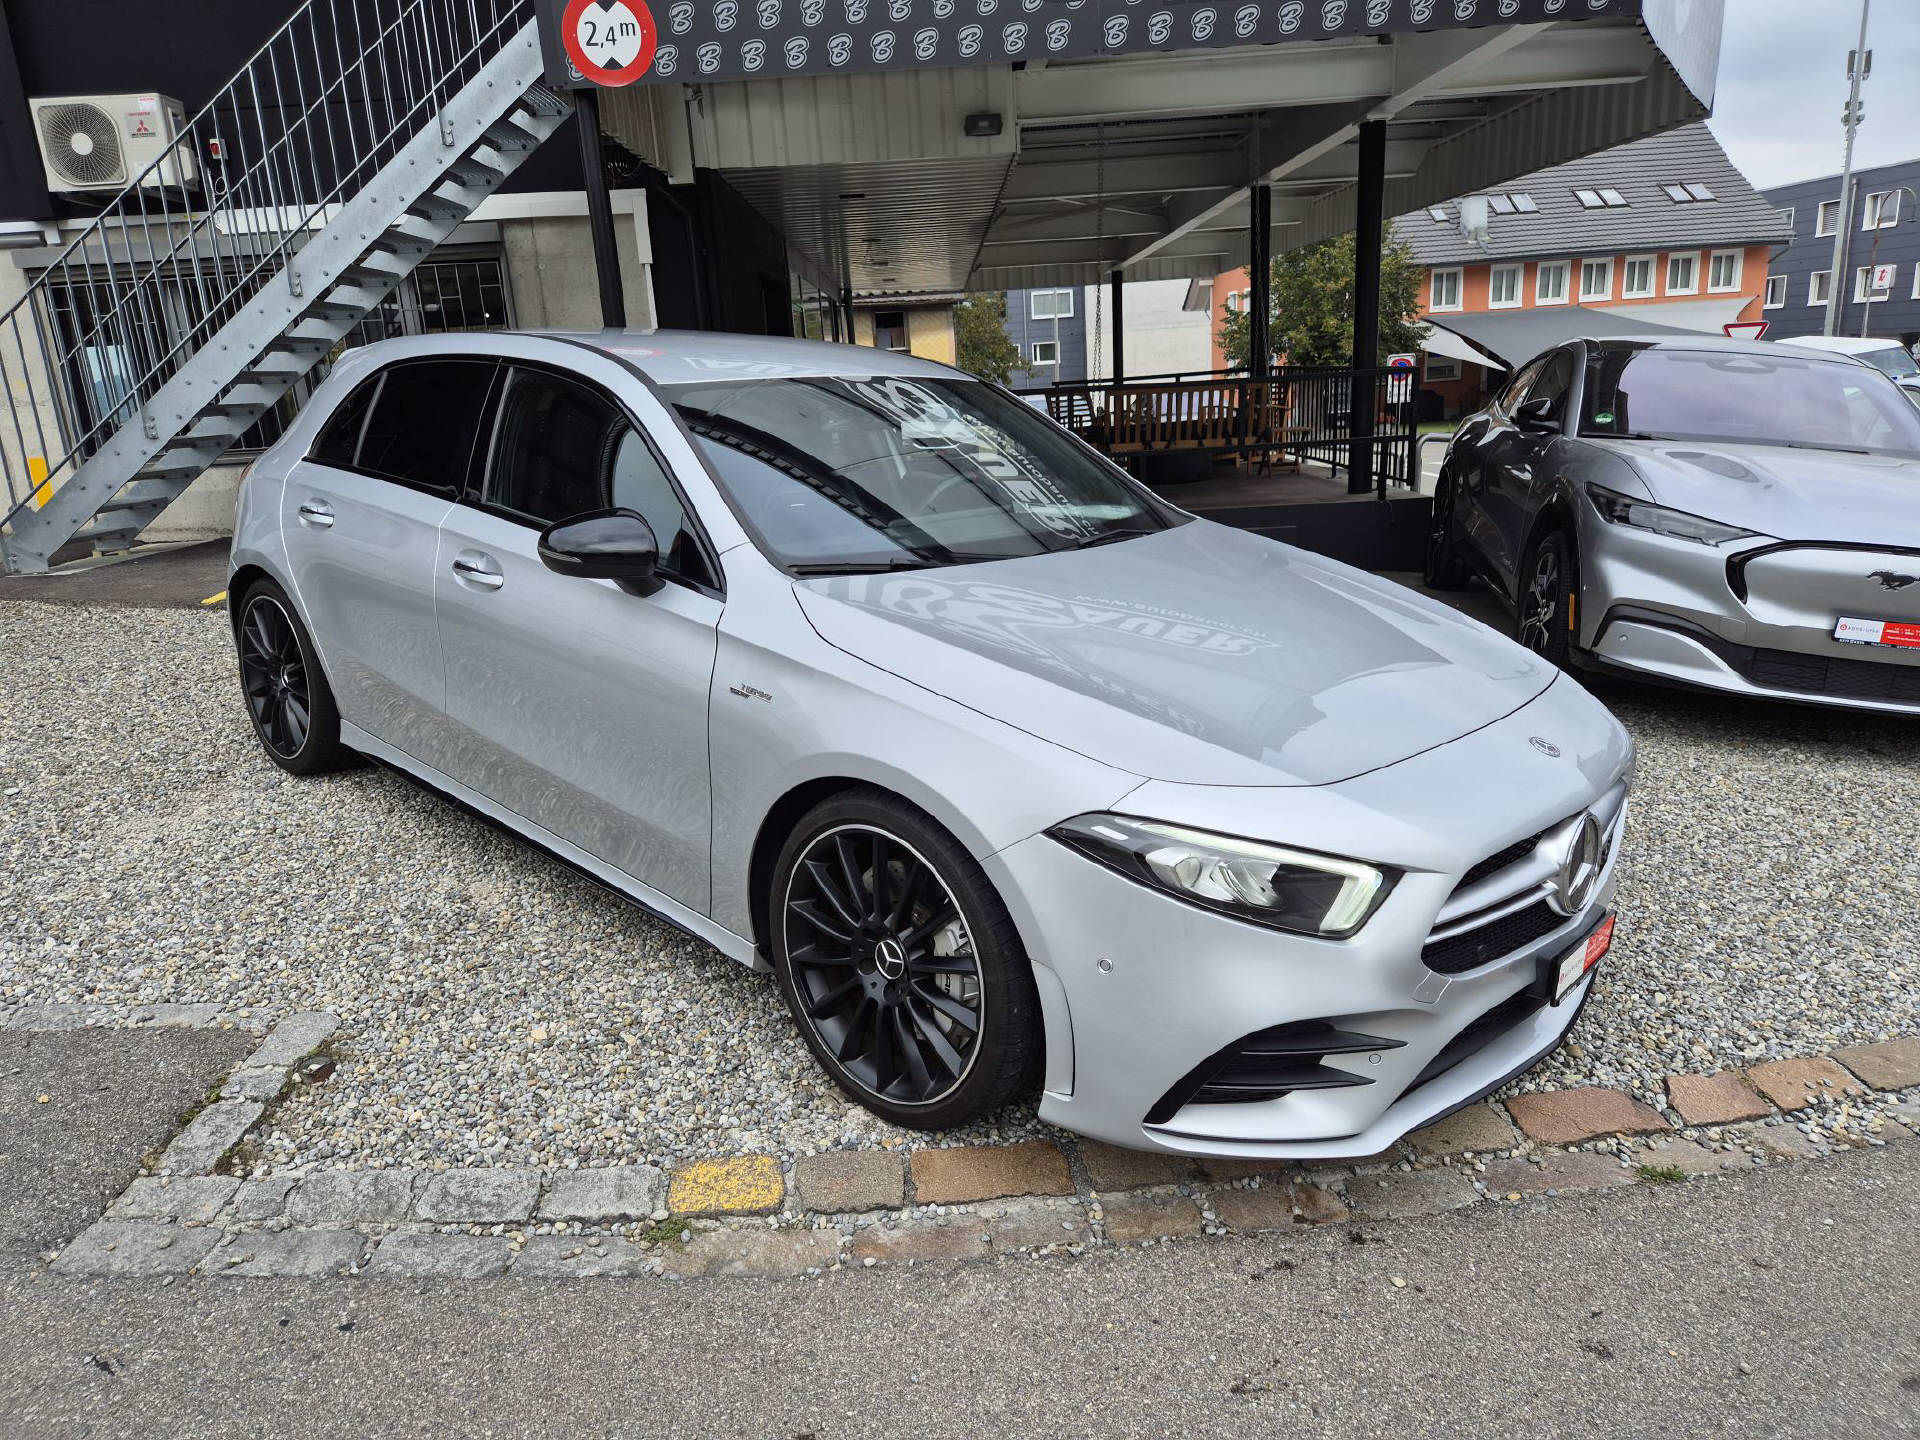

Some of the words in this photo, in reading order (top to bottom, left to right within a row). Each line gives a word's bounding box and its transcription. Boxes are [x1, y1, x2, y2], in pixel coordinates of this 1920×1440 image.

[651, 45, 678, 76] B
[697, 42, 721, 73] B
[741, 39, 766, 71] B
[784, 36, 809, 69] B
[827, 33, 852, 66] B
[870, 30, 895, 63] B
[914, 27, 938, 60] B
[958, 24, 983, 57] B
[1003, 22, 1028, 54] B
[1046, 19, 1071, 51] B
[1104, 15, 1129, 47] B
[1148, 11, 1173, 44] B
[1191, 8, 1217, 41] B
[1235, 4, 1260, 37] B
[1278, 1, 1304, 34] B
[1321, 0, 1347, 30] B
[1366, 0, 1392, 27] B
[669, 1, 694, 35] B
[713, 0, 738, 32] B
[757, 0, 782, 29] B
[800, 0, 825, 26] B
